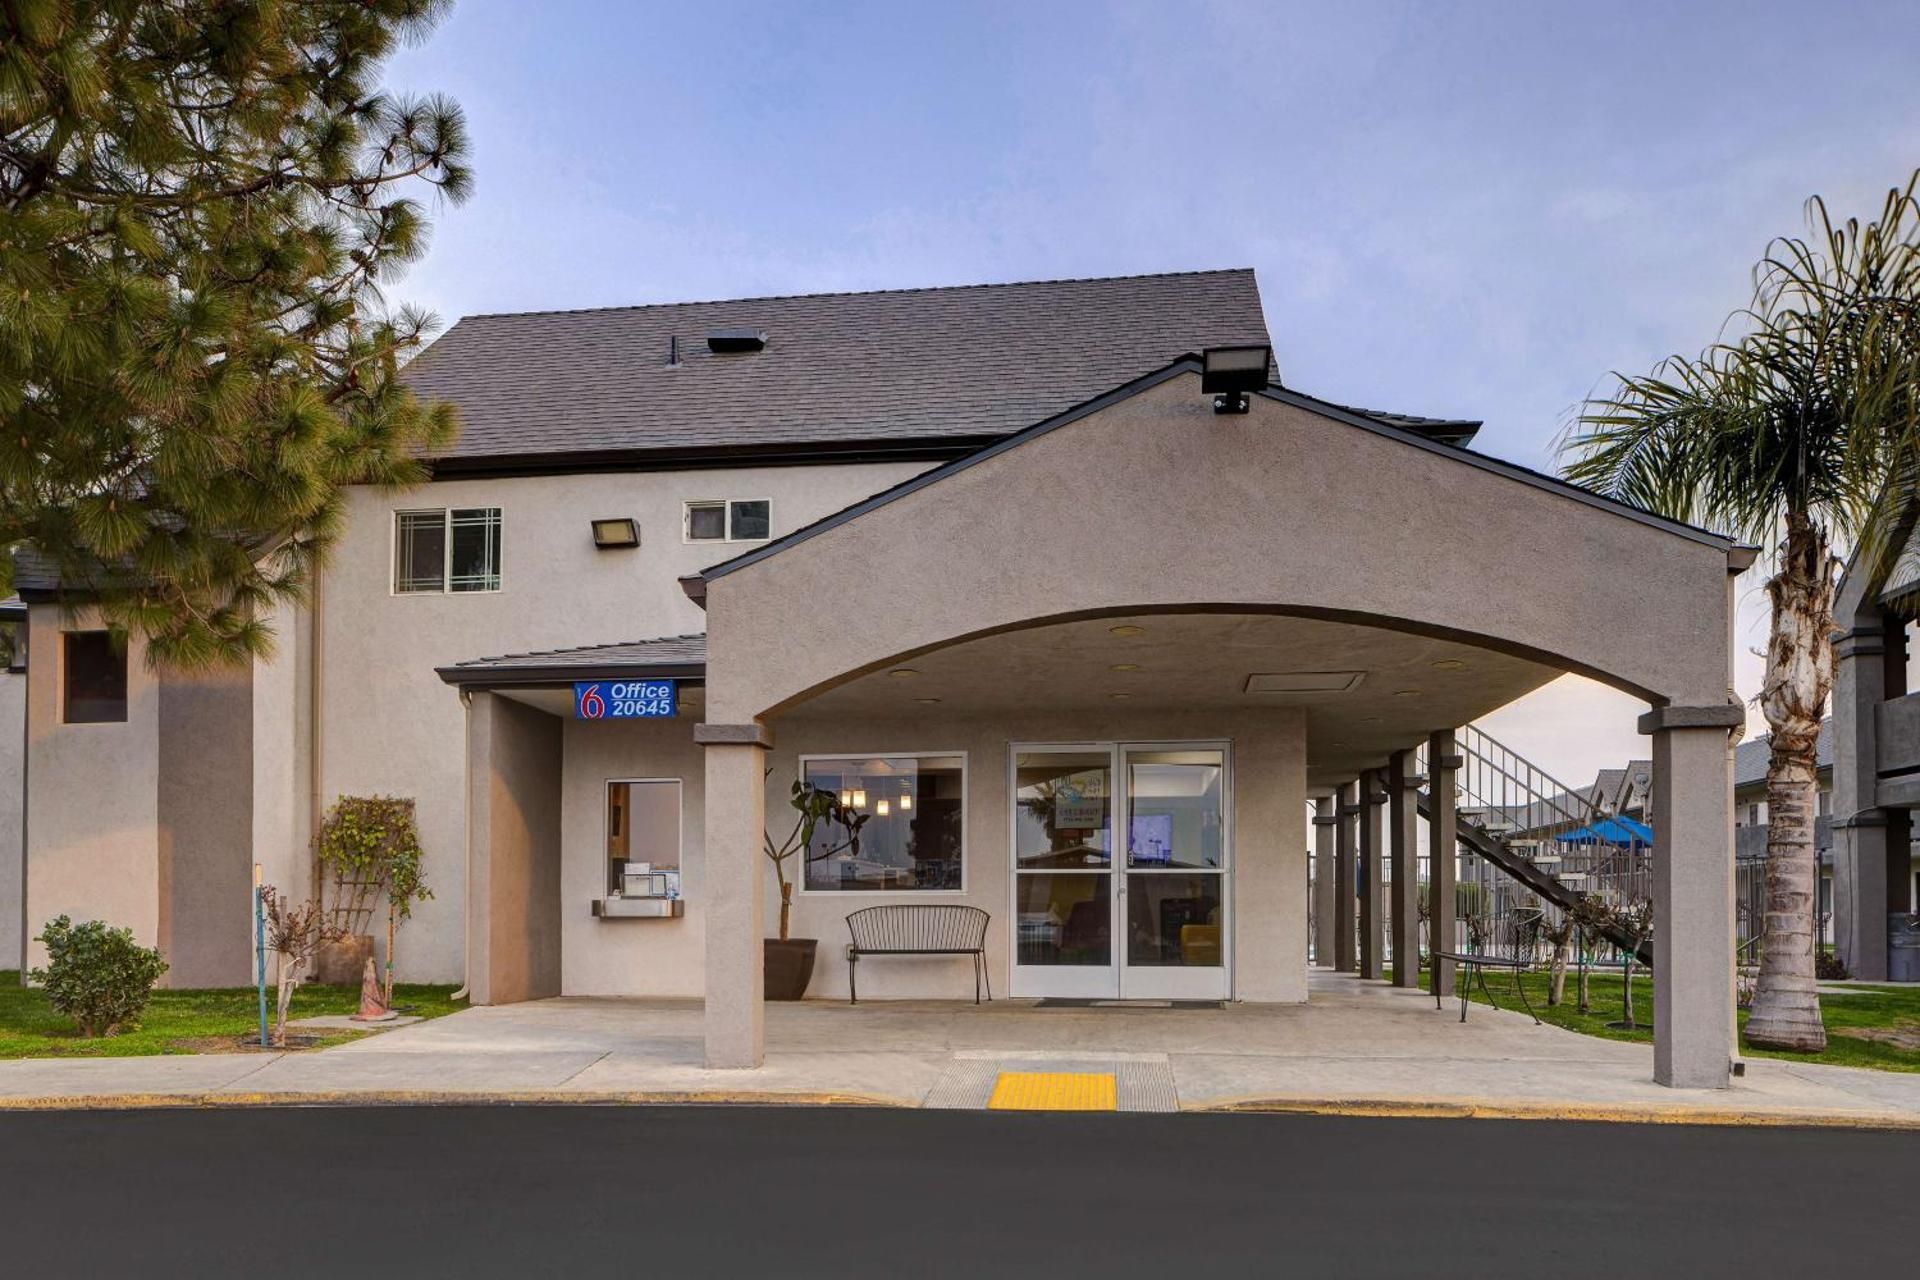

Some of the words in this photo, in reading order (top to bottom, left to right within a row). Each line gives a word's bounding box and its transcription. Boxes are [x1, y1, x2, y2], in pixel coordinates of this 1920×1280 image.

[611, 683, 670, 699] Office
[581, 684, 605, 718] 6
[612, 700, 670, 715] 20645
